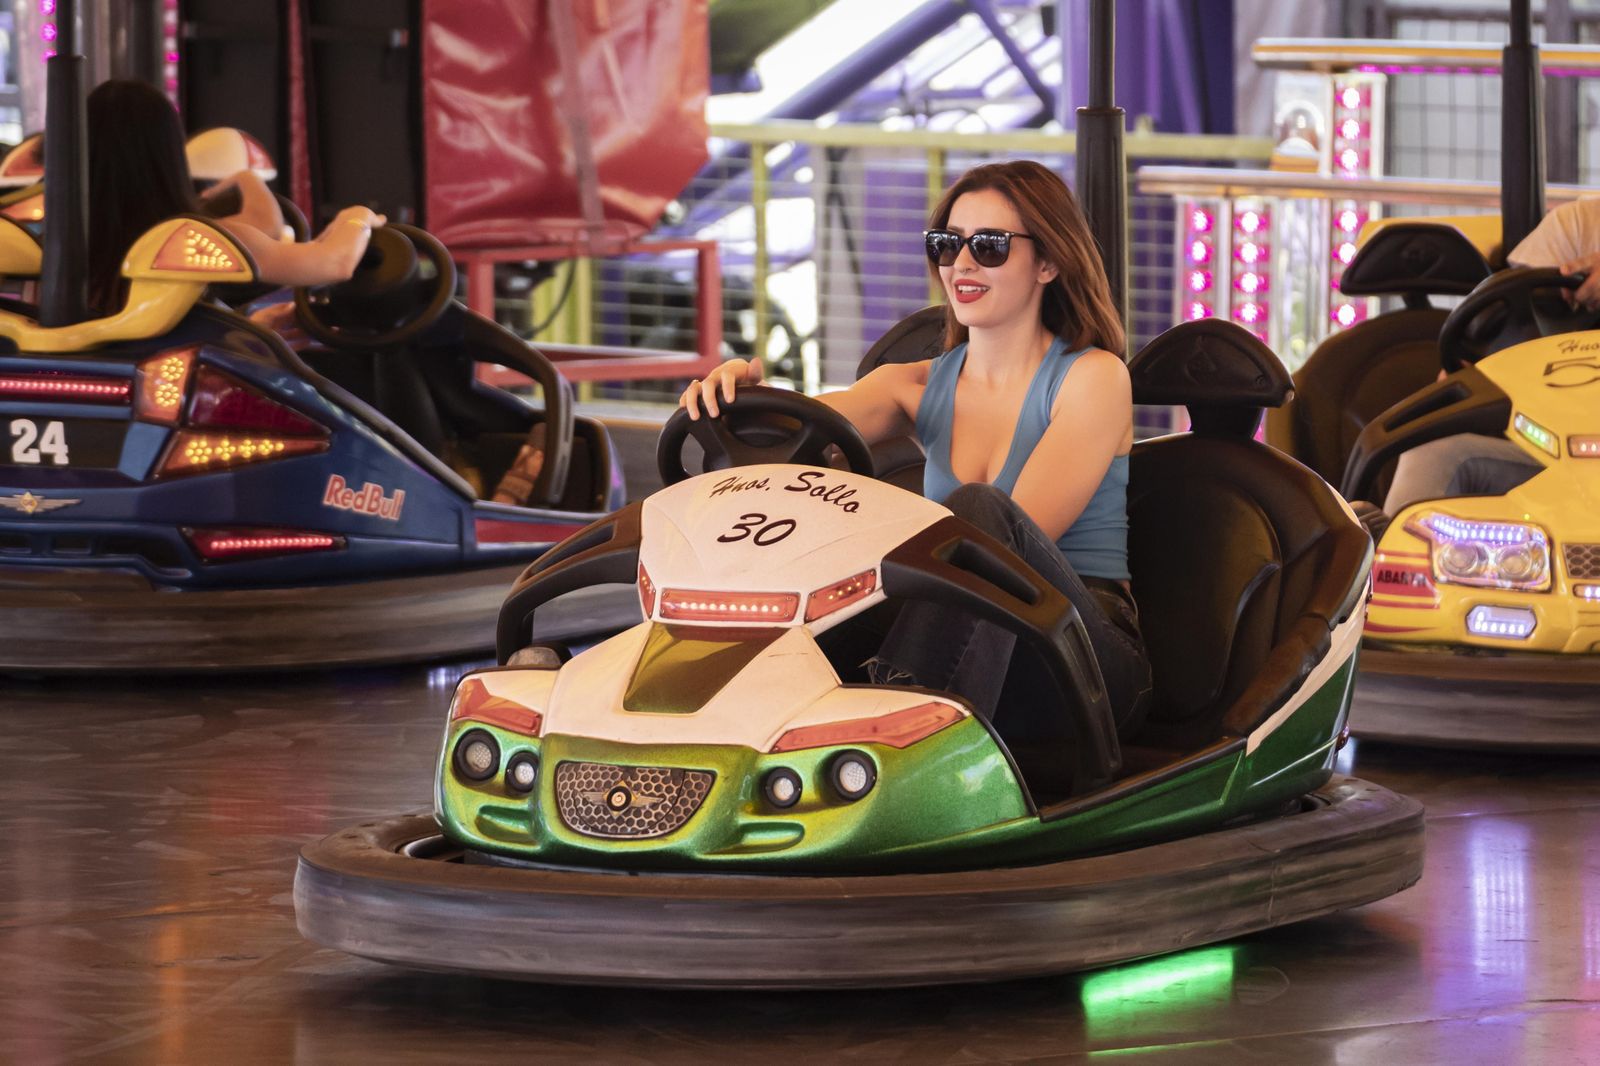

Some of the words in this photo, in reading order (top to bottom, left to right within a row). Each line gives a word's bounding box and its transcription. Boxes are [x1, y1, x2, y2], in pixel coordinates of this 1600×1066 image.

[10, 418, 69, 465] 24
[709, 476, 771, 499] Hnos.
[784, 471, 861, 514] Sollo
[717, 513, 797, 547] 30
